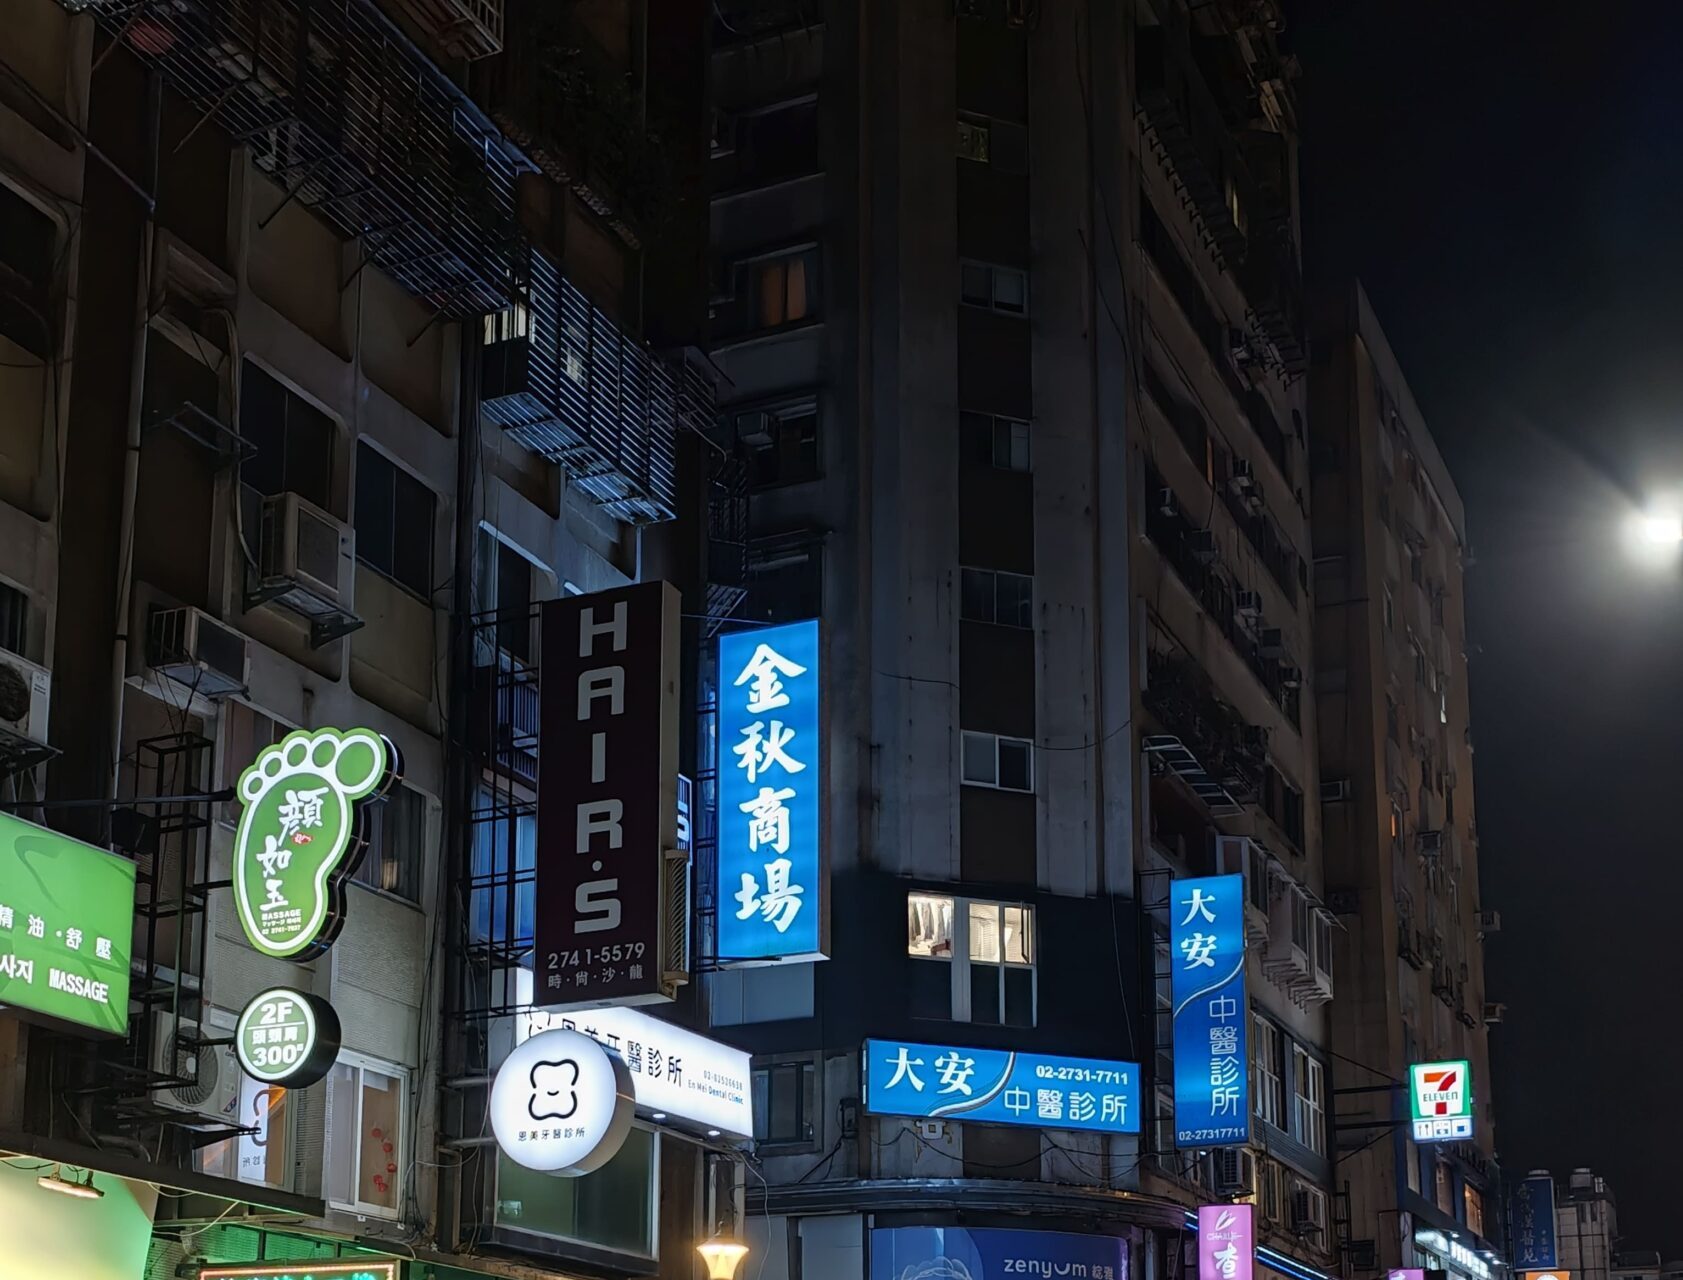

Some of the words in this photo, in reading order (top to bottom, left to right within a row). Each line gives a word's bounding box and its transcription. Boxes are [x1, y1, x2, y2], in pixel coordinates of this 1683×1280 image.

[733, 643, 807, 934] 金秋商場
[256, 787, 330, 911] 顏如玉
[1181, 889, 1217, 970] 大安
[548, 942, 645, 969] 2741-5579
[49, 968, 109, 1003] MASSAGE
[260, 1001, 294, 1024] 2F
[884, 1047, 975, 1096] 大安
[1209, 995, 1240, 1117] 中醫診所
[1036, 1065, 1128, 1085] 02-2731-7711
[1004, 1085, 1128, 1125] 中醫診所
[518, 1127, 586, 1142] 恩美牙醫診所
[1179, 1127, 1246, 1141] 02-27317711
[1004, 1259, 1087, 1279] zenyum
